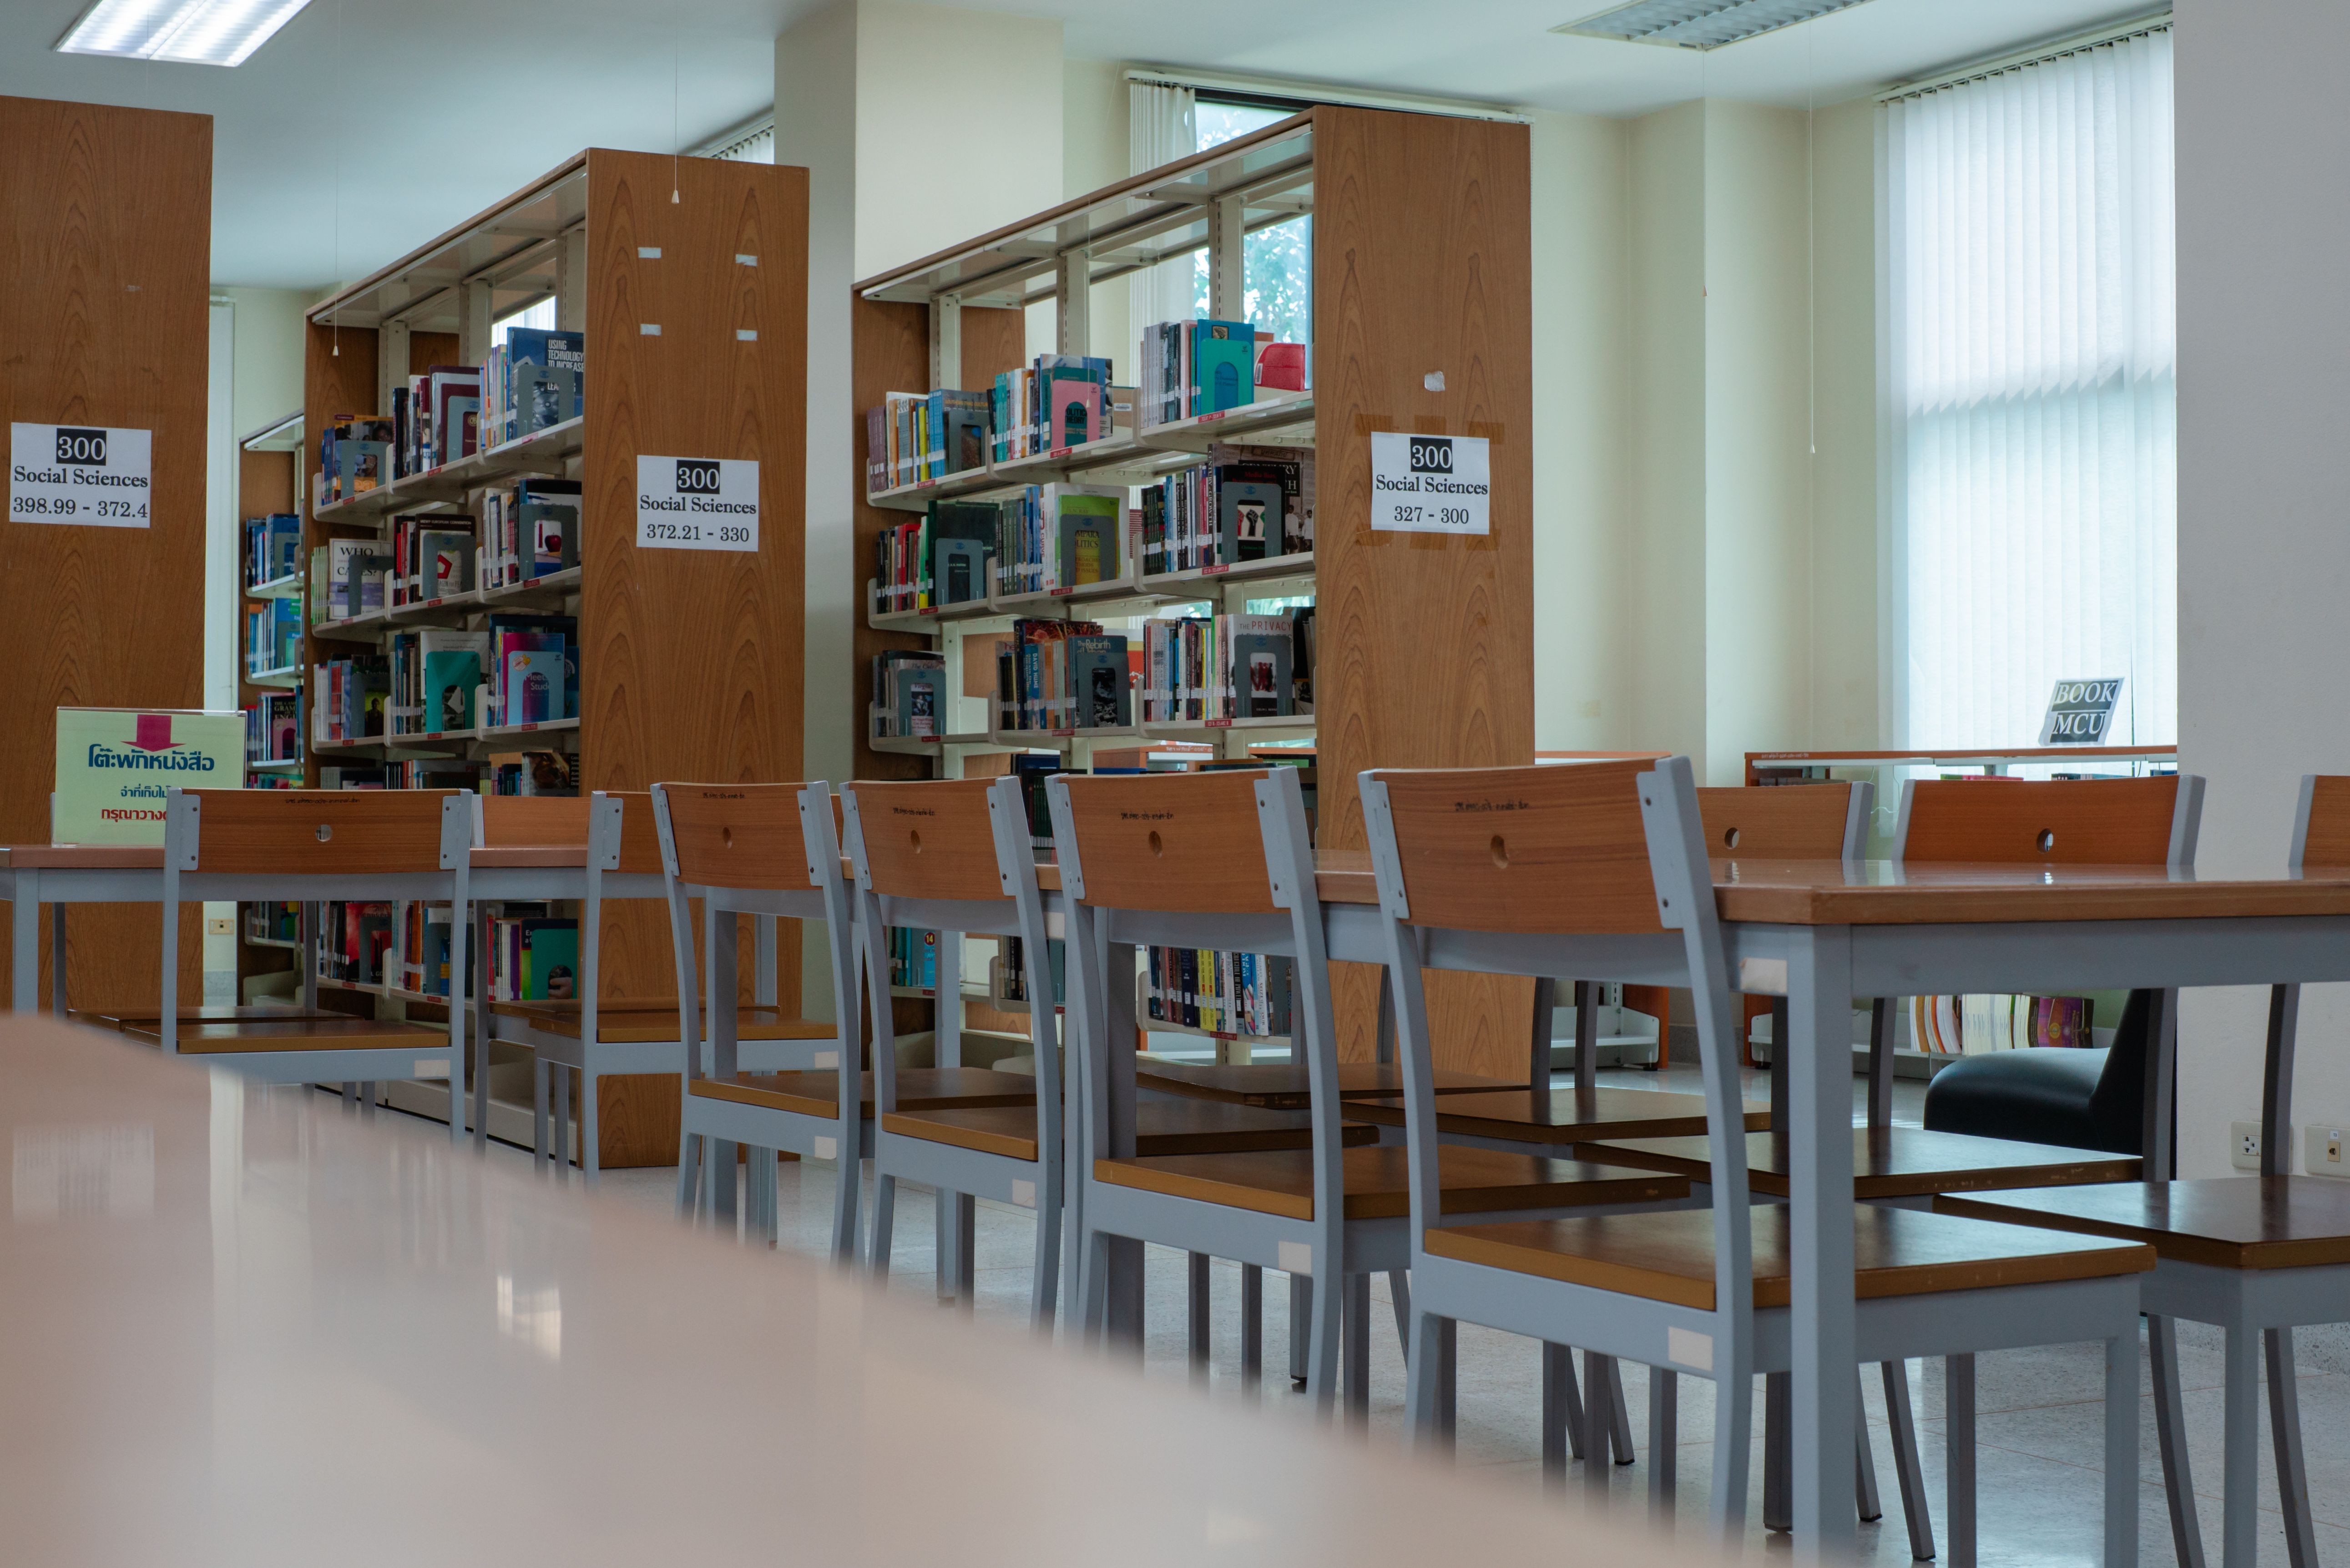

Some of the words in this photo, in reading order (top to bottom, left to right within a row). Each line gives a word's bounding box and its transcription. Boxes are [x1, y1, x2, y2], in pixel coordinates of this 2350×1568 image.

[548, 339, 567, 350] USING
[547, 349, 584, 362] TECHNOLOGY
[547, 359, 555, 368] TO
[556, 360, 584, 373] INCREASE
[57, 436, 106, 460] 300
[1411, 445, 1452, 468] 300
[14, 465, 68, 484] Social
[73, 468, 148, 487] Sciences
[677, 467, 720, 490] 300
[1376, 474, 1420, 491] Social
[1425, 477, 1488, 495] Sciences
[13, 497, 76, 515] 398.99
[97, 501, 148, 518] 372.4
[640, 495, 687, 511] Social
[691, 497, 757, 514] Sciences
[1394, 506, 1423, 522] 327
[1440, 508, 1469, 524] 300
[647, 524, 701, 540] 372.21
[720, 526, 749, 542] 330
[340, 547, 374, 556] WHO
[1076, 540, 1099, 548] LITICS
[337, 567, 377, 576] CAES?
[1252, 621, 1292, 631] PRIVACY
[1086, 638, 1111, 649] Rebirth
[531, 682, 550, 690] Stud
[2054, 682, 2118, 703] BOOK
[2052, 713, 2106, 735] MCU
[88, 744, 215, 772] โต๊ะพักหนังสือ
[926, 934, 934, 943] 14
